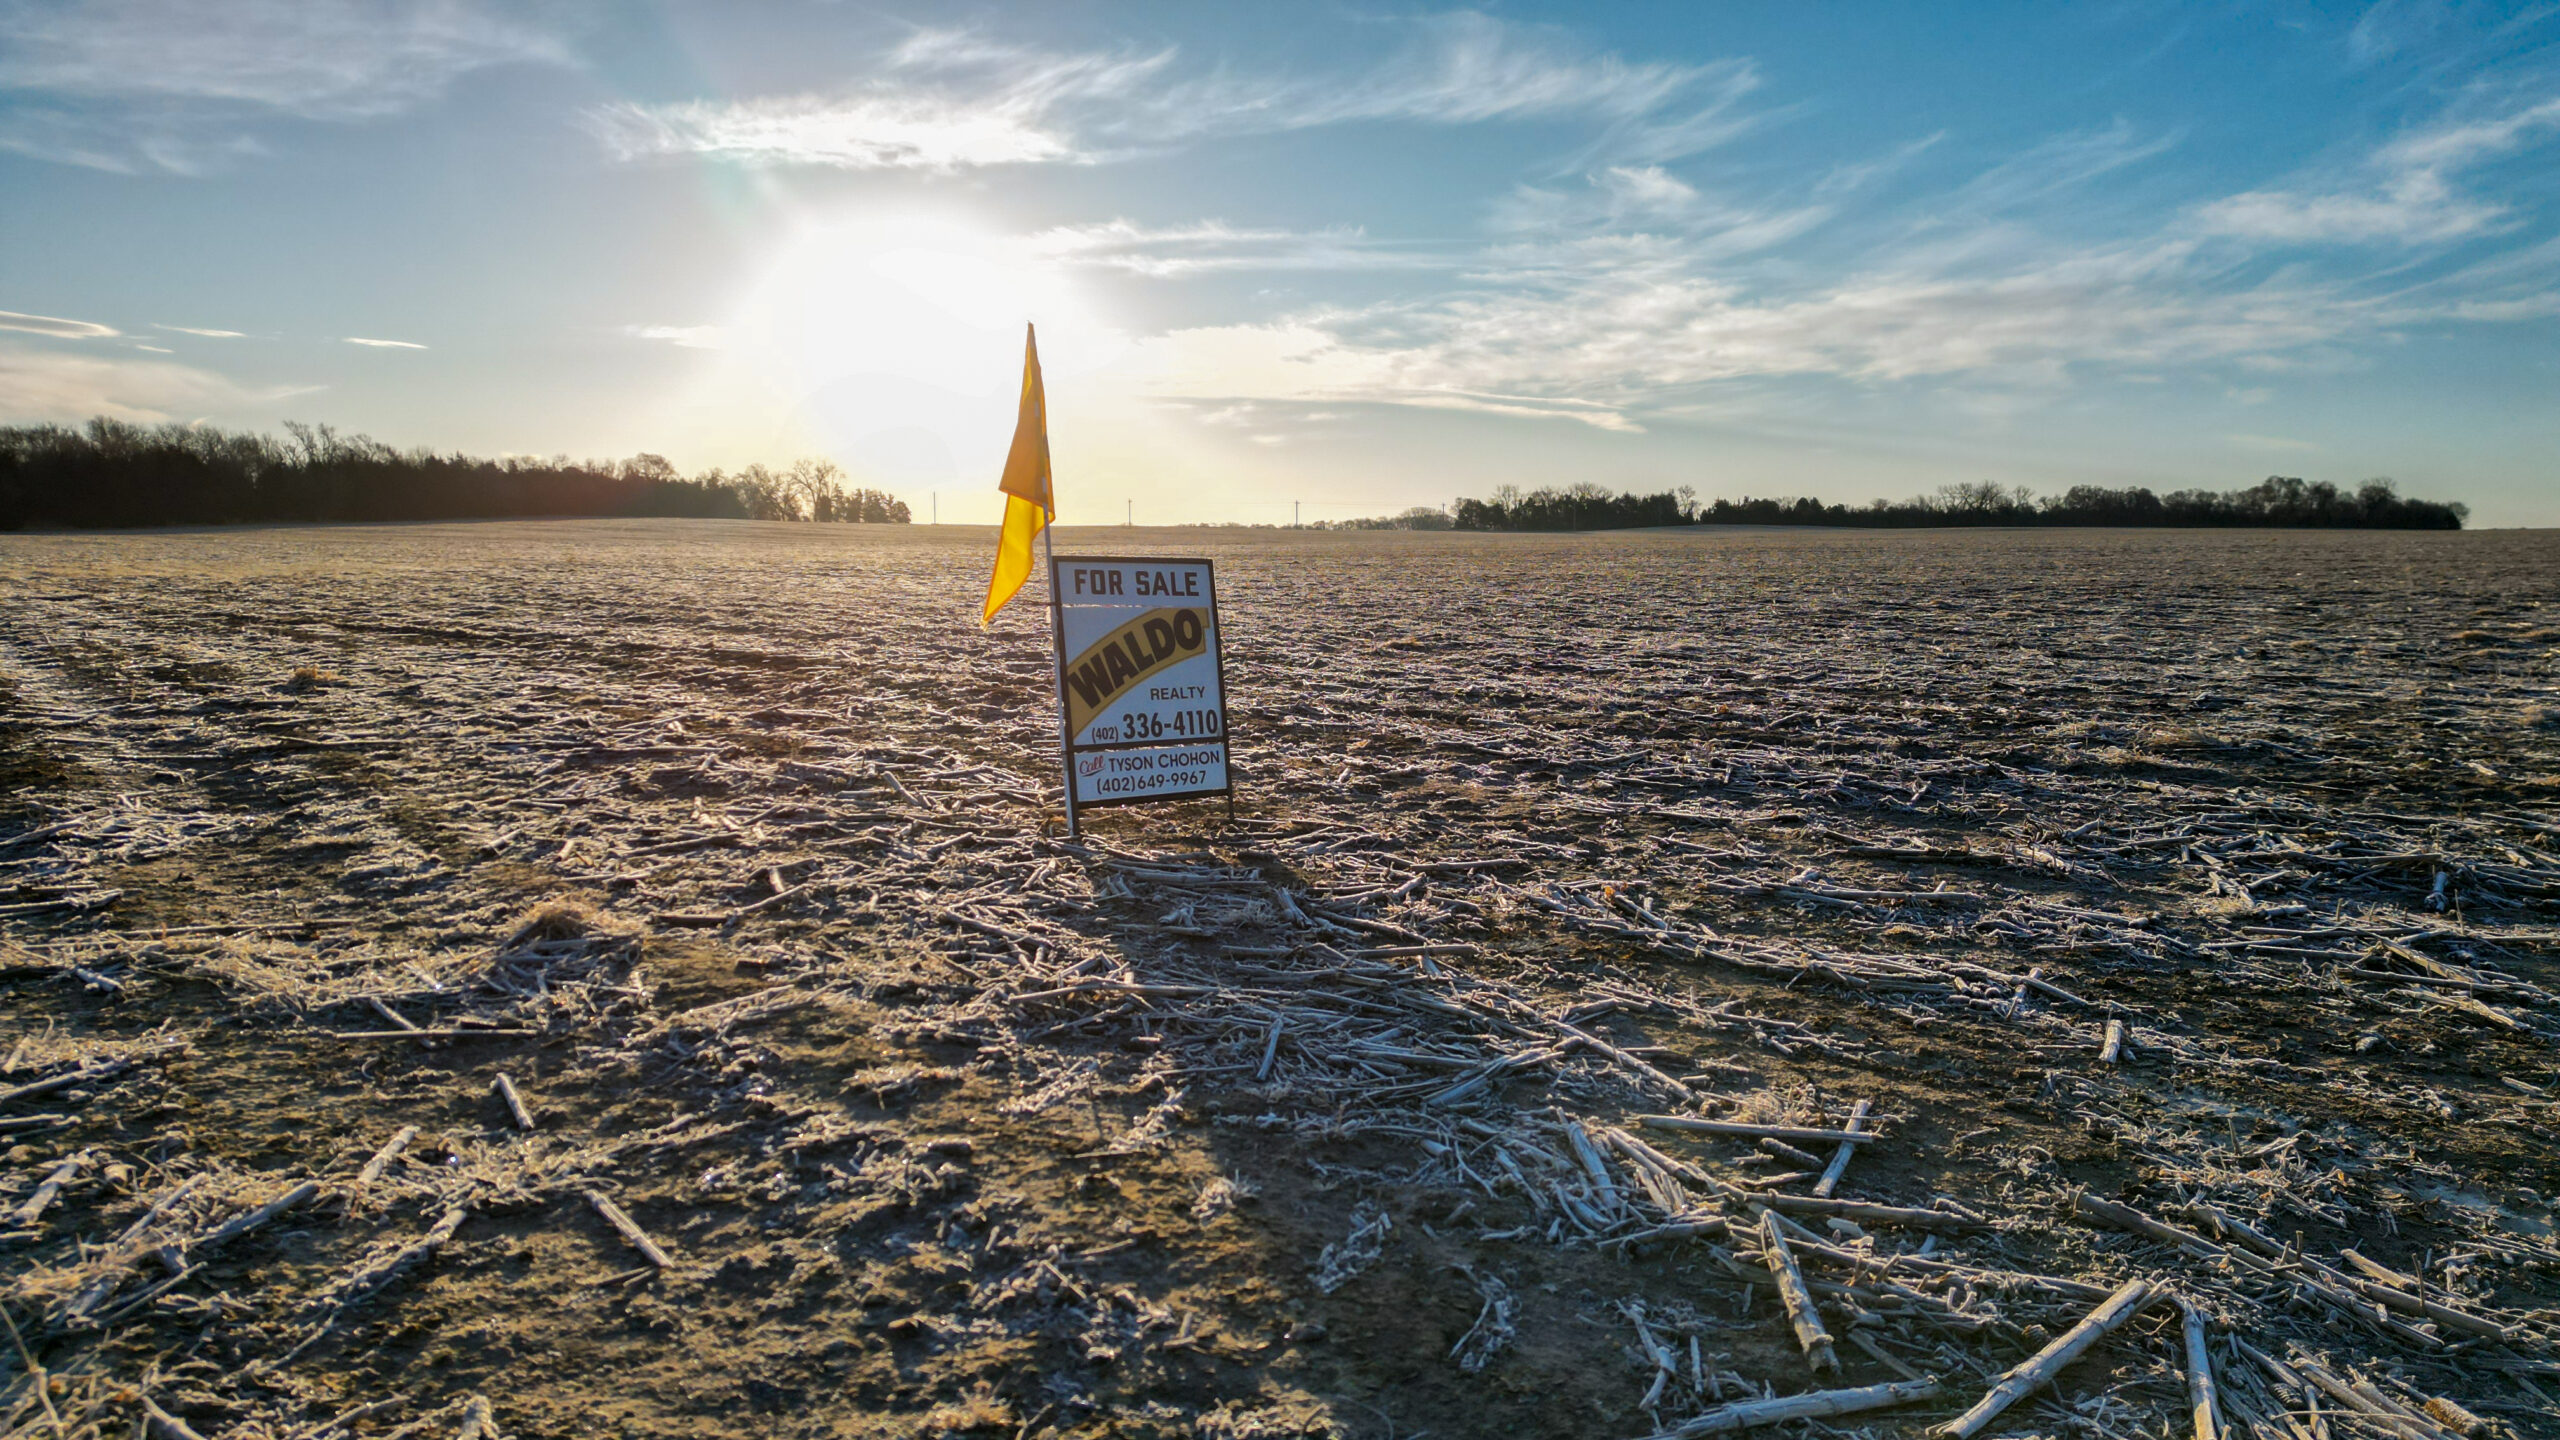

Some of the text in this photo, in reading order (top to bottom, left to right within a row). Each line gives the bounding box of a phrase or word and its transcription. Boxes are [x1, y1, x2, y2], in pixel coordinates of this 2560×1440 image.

[1074, 569, 1200, 597] FOR SALE
[1066, 608, 1203, 709] WALDO
[1150, 686, 1206, 700] REALTY
[1091, 709, 1218, 744] (402) 336-4110
[1079, 751, 1220, 775] Call TYSON CHOHON
